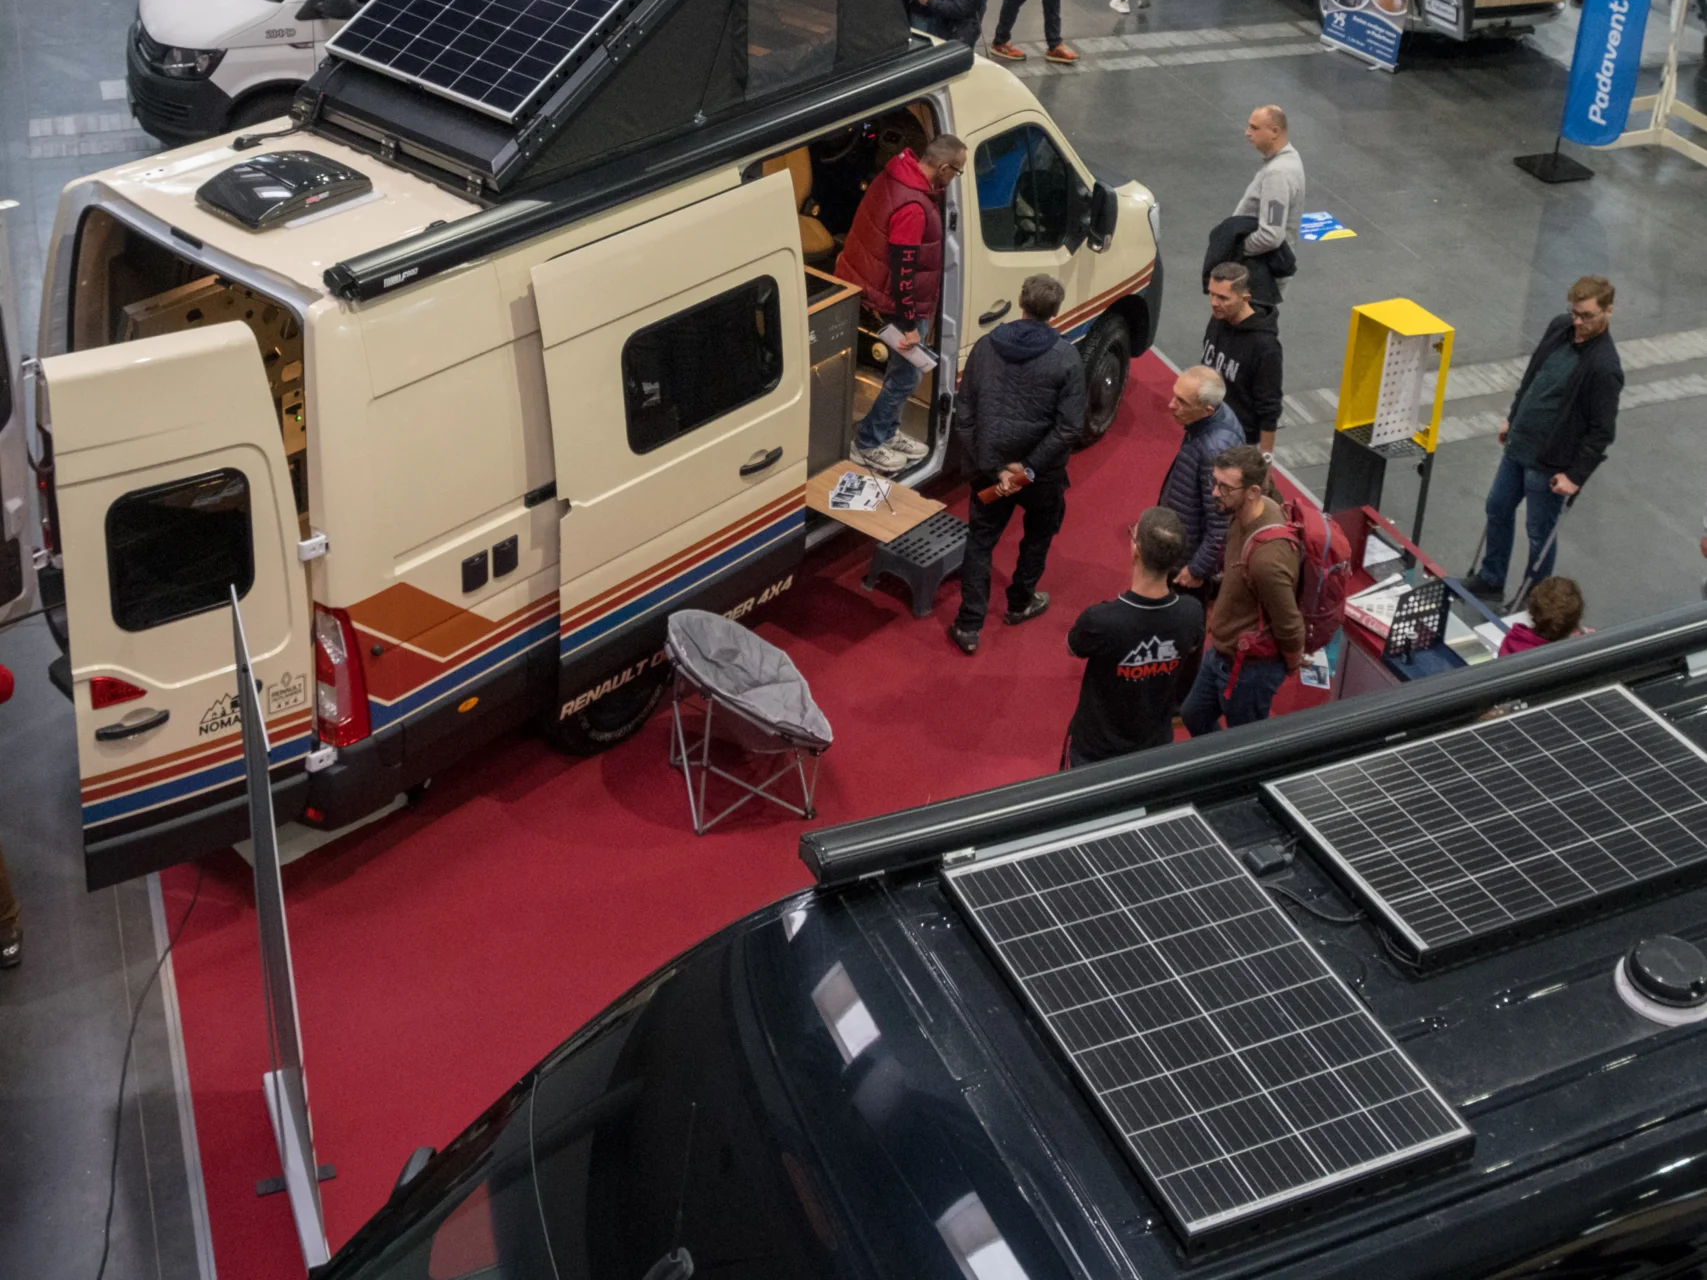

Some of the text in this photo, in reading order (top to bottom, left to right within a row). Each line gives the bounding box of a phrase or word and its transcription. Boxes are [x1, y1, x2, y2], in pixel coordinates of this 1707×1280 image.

[899, 249, 916, 322] EARTH
[560, 658, 650, 721] RENAULT
[756, 574, 795, 607] 4X4
[1116, 658, 1180, 680] NOMAD
[198, 715, 242, 736] NOMA
